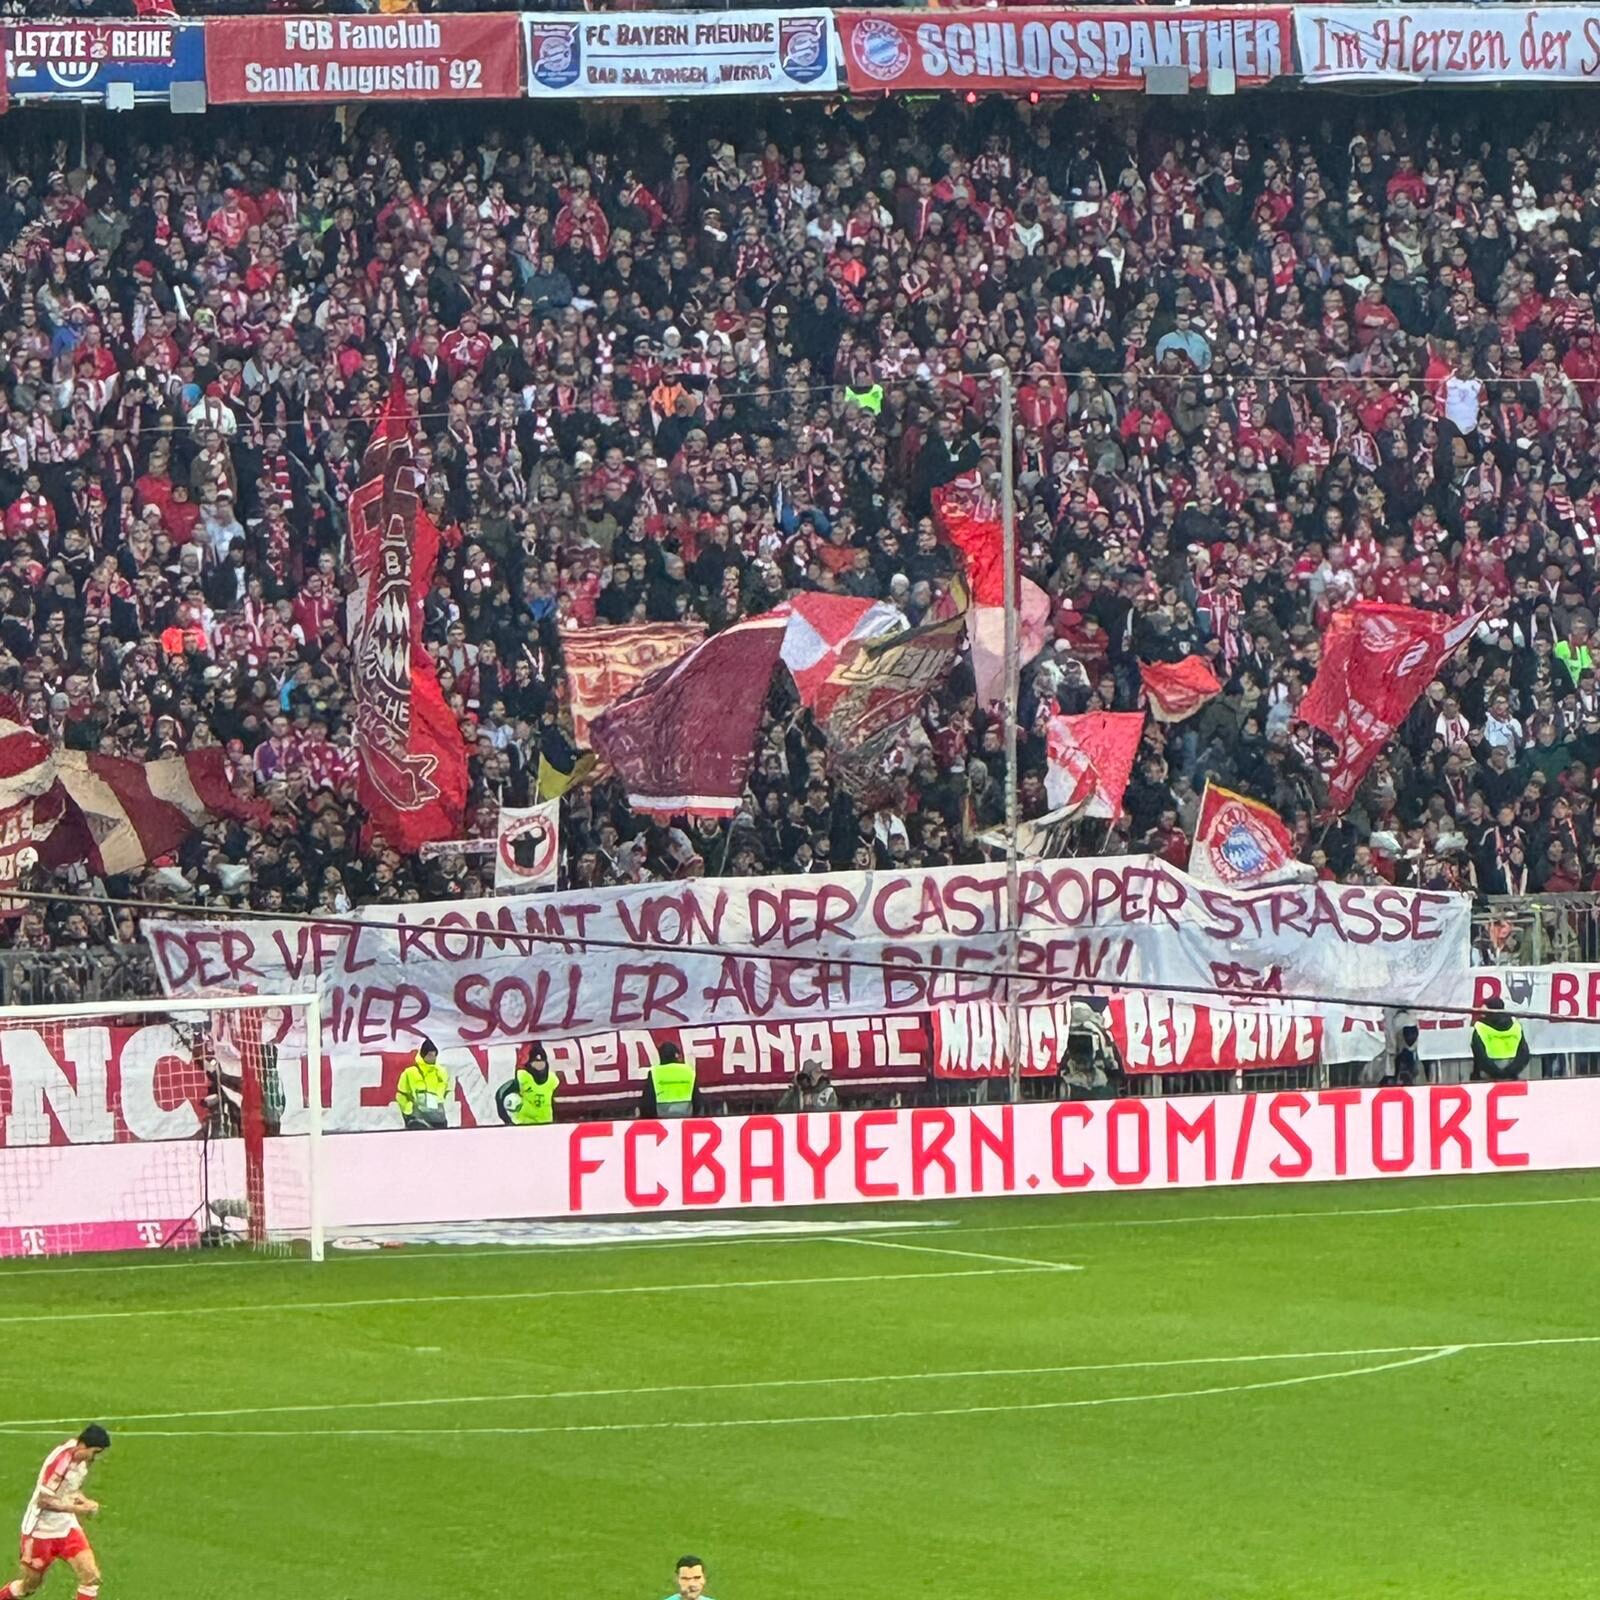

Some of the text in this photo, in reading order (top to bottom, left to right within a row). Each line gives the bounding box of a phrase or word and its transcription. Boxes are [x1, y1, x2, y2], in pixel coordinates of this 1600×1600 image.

[15, 31, 171, 57] LETZTE REIHE
[284, 20, 441, 50] FCB Fanclub
[586, 24, 610, 46] FC
[617, 24, 689, 46] BAYERN
[696, 23, 775, 45] FREUNDE
[916, 20, 1282, 80] SCHLOSSPANTHER
[1313, 17, 1368, 71] Im
[1373, 15, 1511, 73] Herzen
[1520, 10, 1572, 71] der
[245, 62, 320, 93] Sankt
[323, 60, 439, 94] Augustin
[586, 65, 618, 84] BAD
[152, 866, 1451, 988] DER VFL KOMMT VON DER CASTROPER STRASSE
[455, 963, 594, 1041] SOLL
[610, 961, 689, 1024] ER
[703, 951, 851, 1017] AUCH
[1123, 991, 1197, 1068] RED
[1209, 1007, 1316, 1065] PRIDE
[568, 1080, 1530, 1211] FCBAYERN.COM/STORE
